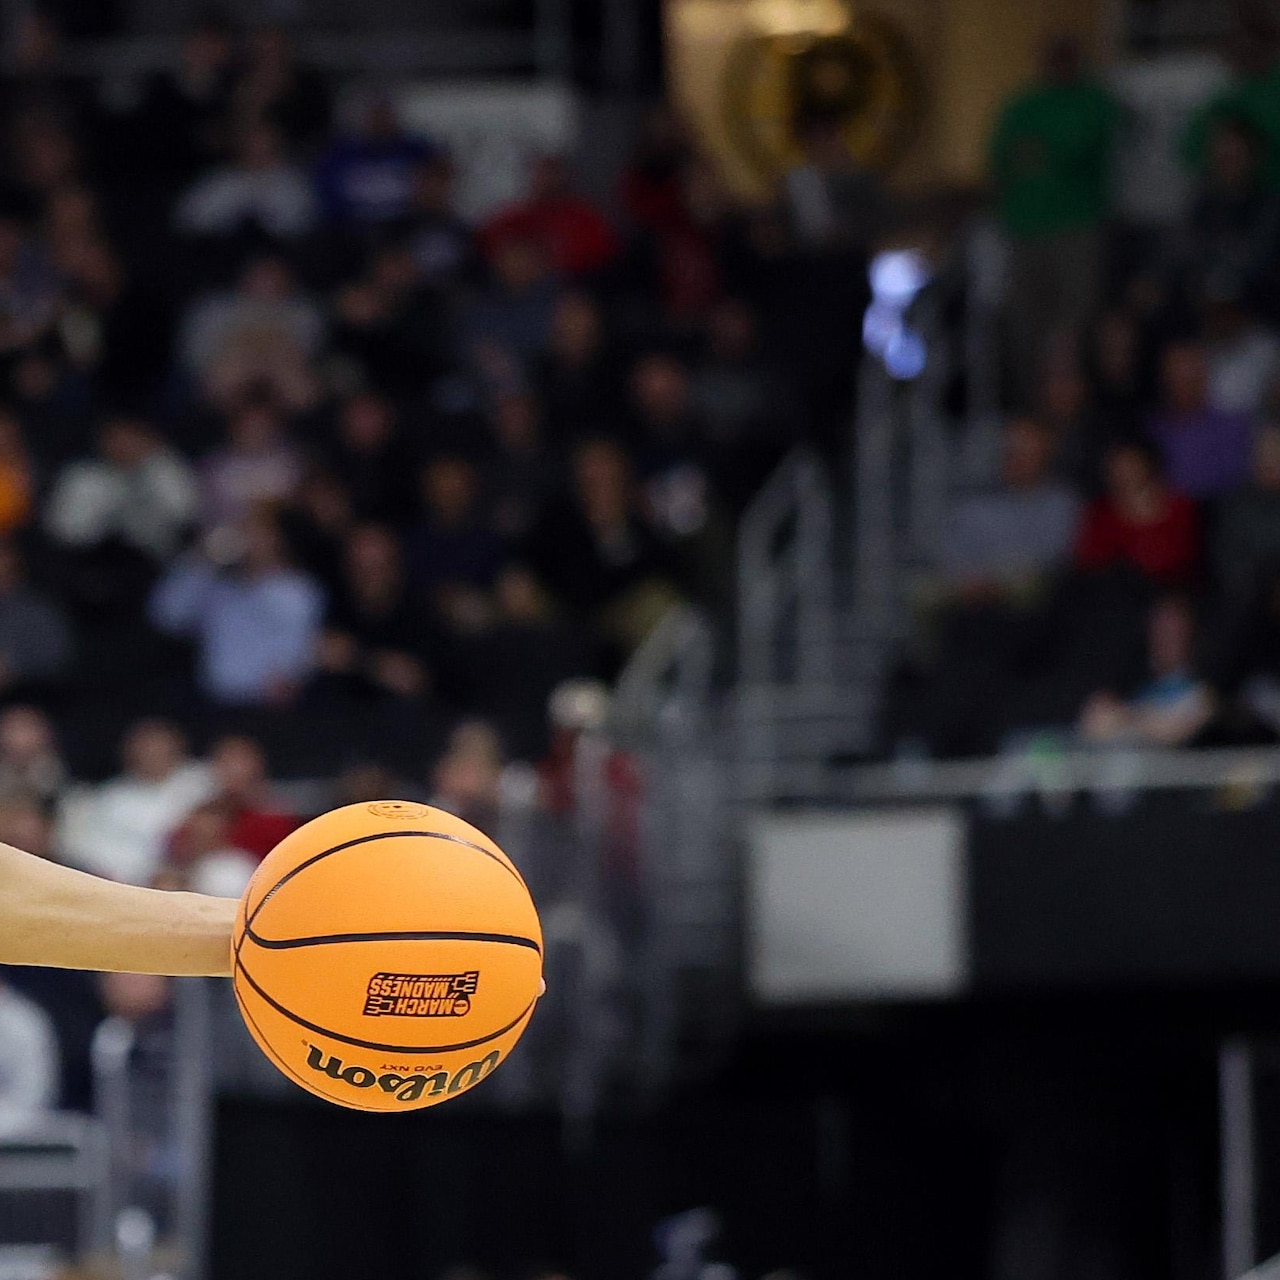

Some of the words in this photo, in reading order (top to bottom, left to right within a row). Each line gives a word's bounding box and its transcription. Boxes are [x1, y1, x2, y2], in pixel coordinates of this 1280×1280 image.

[369, 979, 450, 998] MADNESS
[396, 998, 454, 1014] MARCH
[305, 1044, 502, 1102] Wilson
